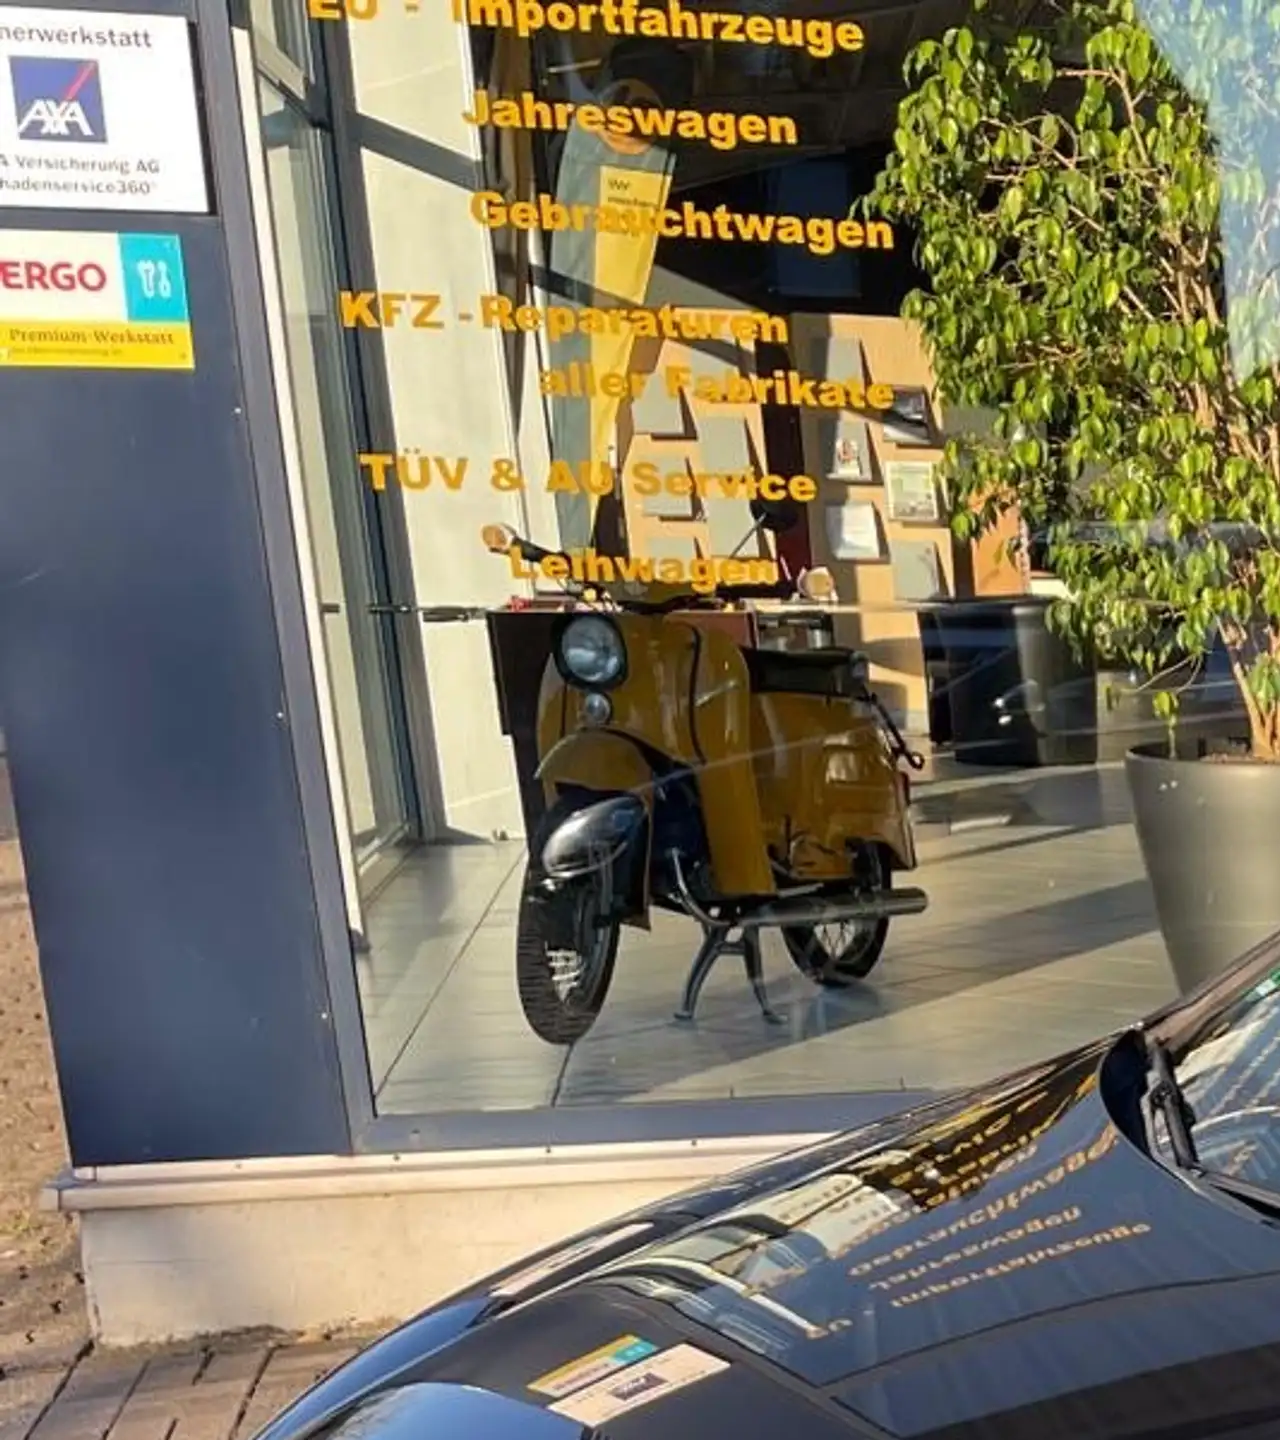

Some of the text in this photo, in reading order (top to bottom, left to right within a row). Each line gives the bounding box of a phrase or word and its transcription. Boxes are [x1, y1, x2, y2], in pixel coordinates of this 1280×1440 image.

[452, 0, 865, 57] Importfahrzeuge
[19, 99, 94, 136] AXA
[462, 89, 798, 150] Jahreswagen
[14, 154, 130, 175] Versicherung
[136, 159, 160, 174] AG
[468, 191, 895, 255] Gebrauchtwagen
[1, 260, 107, 292] ERGO
[340, 291, 444, 330] KFZ
[480, 294, 789, 343] Reparaturen
[539, 362, 895, 410] aller Fabrikate
[359, 447, 818, 502] TÜV & AU Service
[509, 546, 780, 592] Leihwagen
